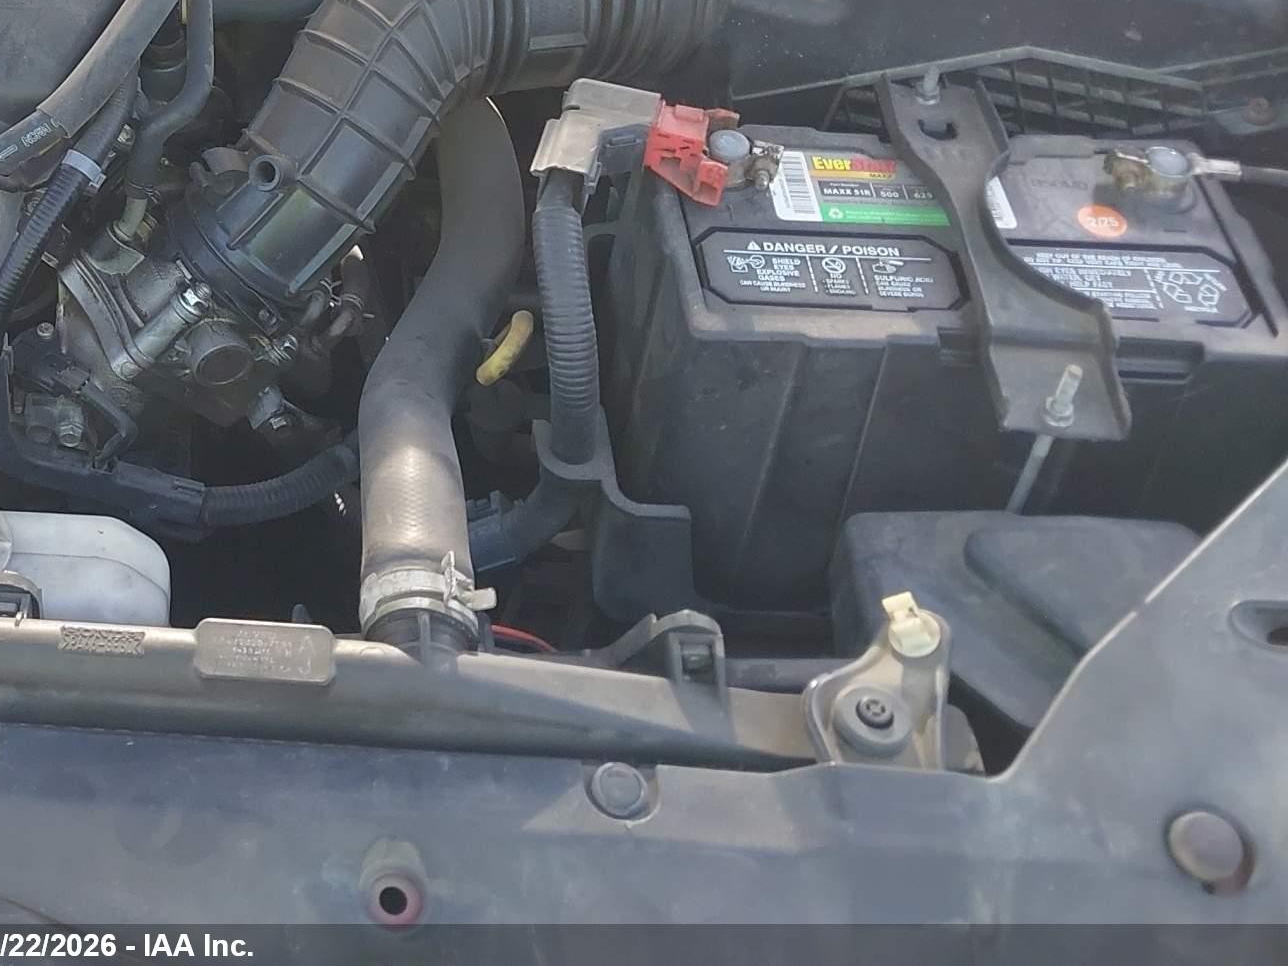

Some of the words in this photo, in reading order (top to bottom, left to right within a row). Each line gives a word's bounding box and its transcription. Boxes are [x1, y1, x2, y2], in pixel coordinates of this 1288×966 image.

[823, 187, 851, 195] MAXX
[763, 242, 826, 254] DANGER
[829, 245, 838, 254] /
[842, 245, 900, 257] POISON
[772, 257, 801, 266] SHIELD
[757, 269, 800, 277] EXPLOSIVE
